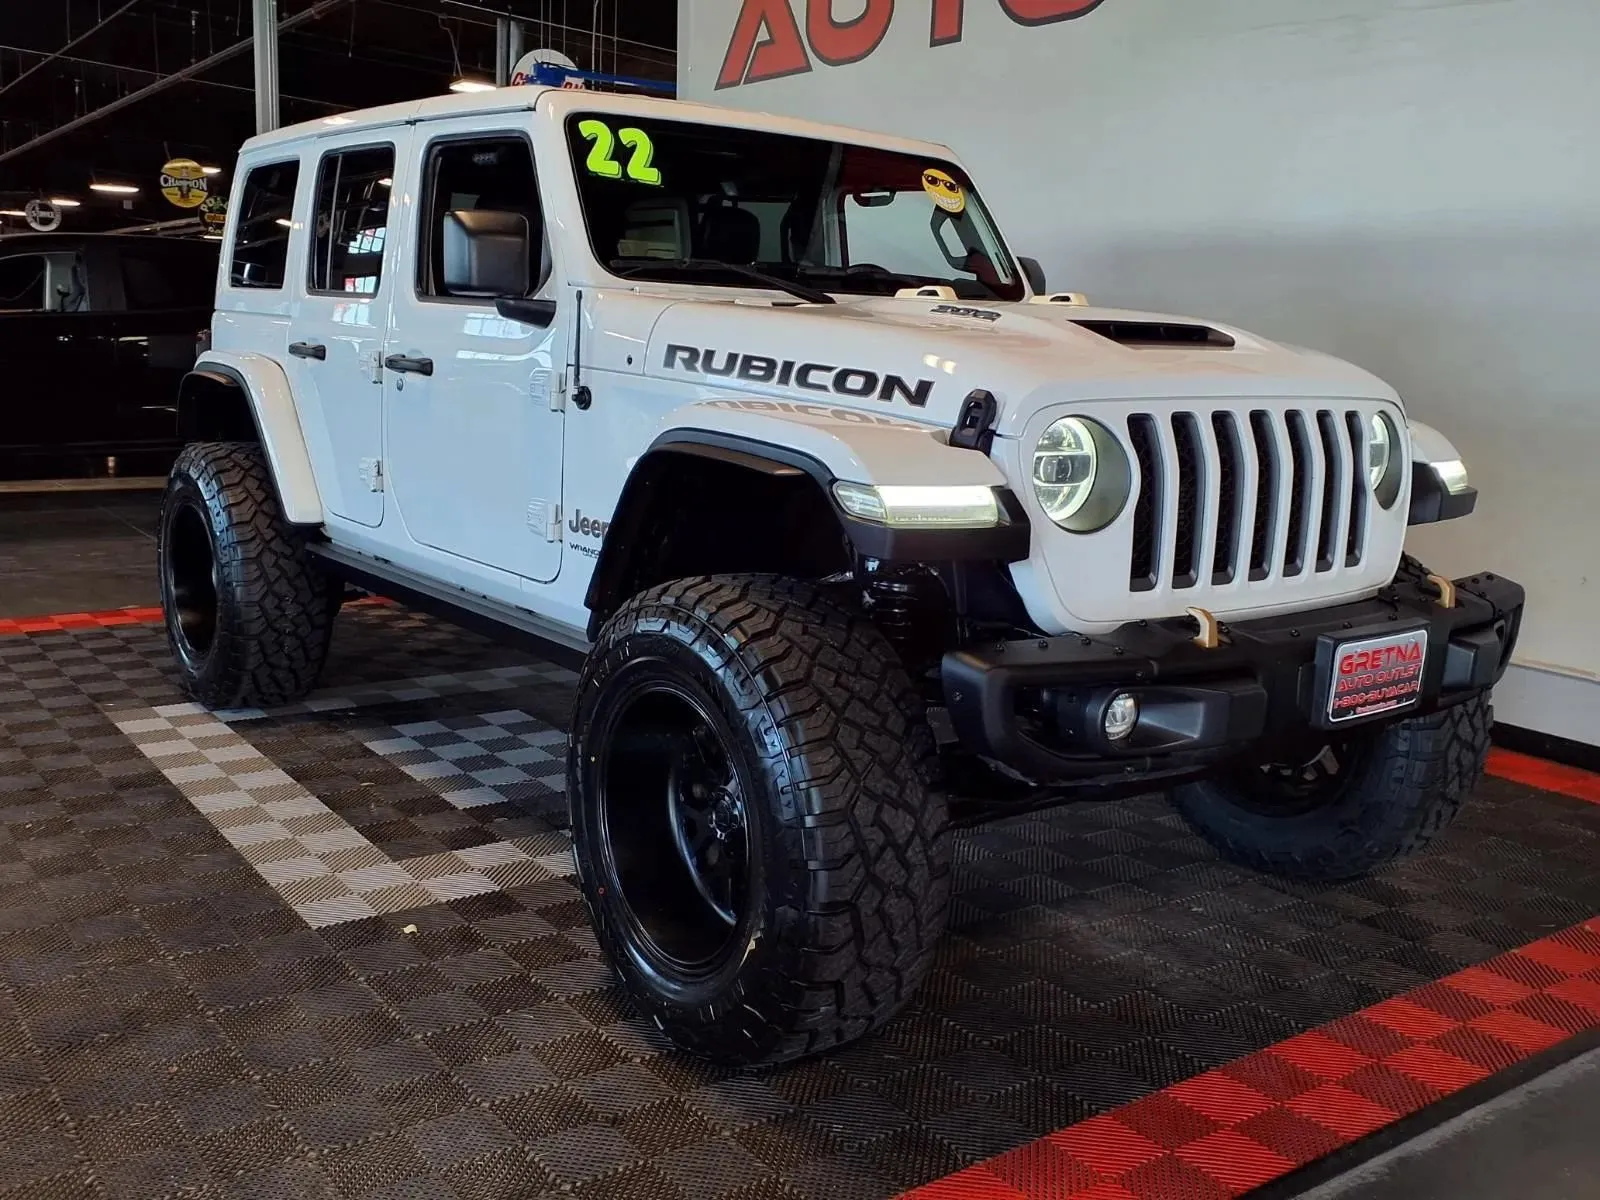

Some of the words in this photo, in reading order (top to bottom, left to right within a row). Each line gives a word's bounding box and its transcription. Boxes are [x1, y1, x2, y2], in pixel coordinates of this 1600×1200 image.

[714, 0, 1106, 90] AU
[578, 119, 662, 186] 22
[663, 343, 935, 409] RUBICON
[1338, 674, 1374, 692] AUTO
[1375, 663, 1422, 684] OUTLET
[1340, 642, 1422, 675] GRETNA
[1333, 680, 1419, 709] 1-800-BUYACAR
